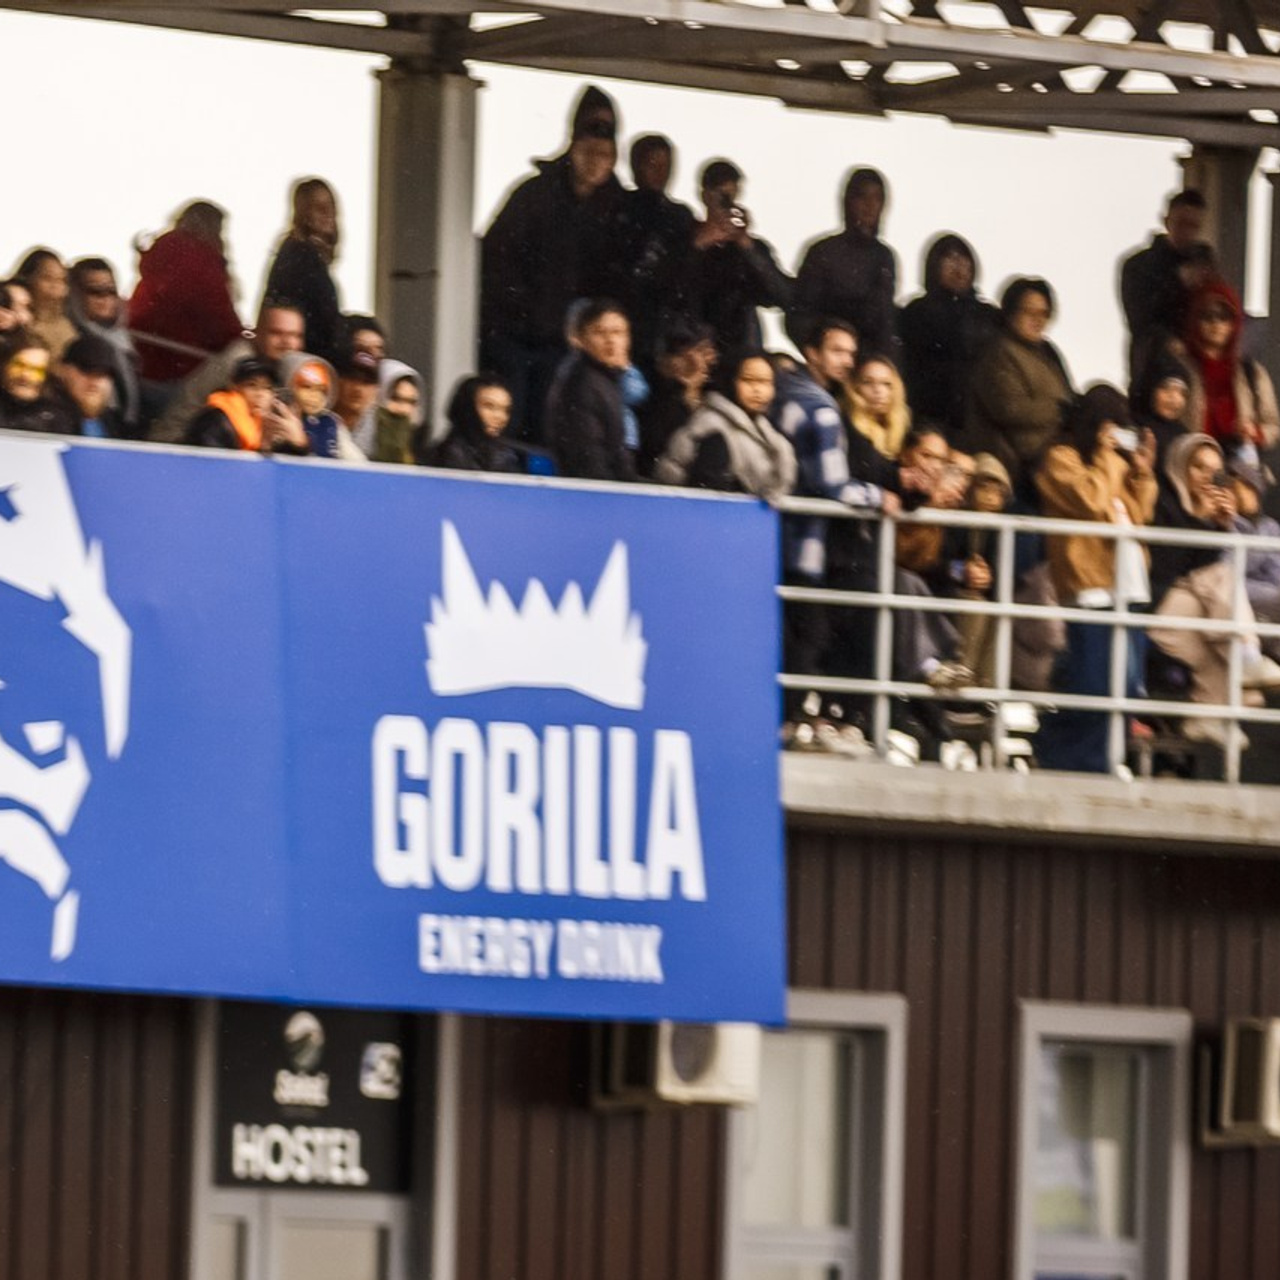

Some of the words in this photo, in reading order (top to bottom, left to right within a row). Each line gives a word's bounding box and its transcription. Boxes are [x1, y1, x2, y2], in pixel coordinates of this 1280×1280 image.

[372, 714, 707, 902] GORILLA
[418, 913, 554, 980] ENERGY
[556, 918, 664, 985] DRINK
[232, 1122, 370, 1186] HOSTEL
